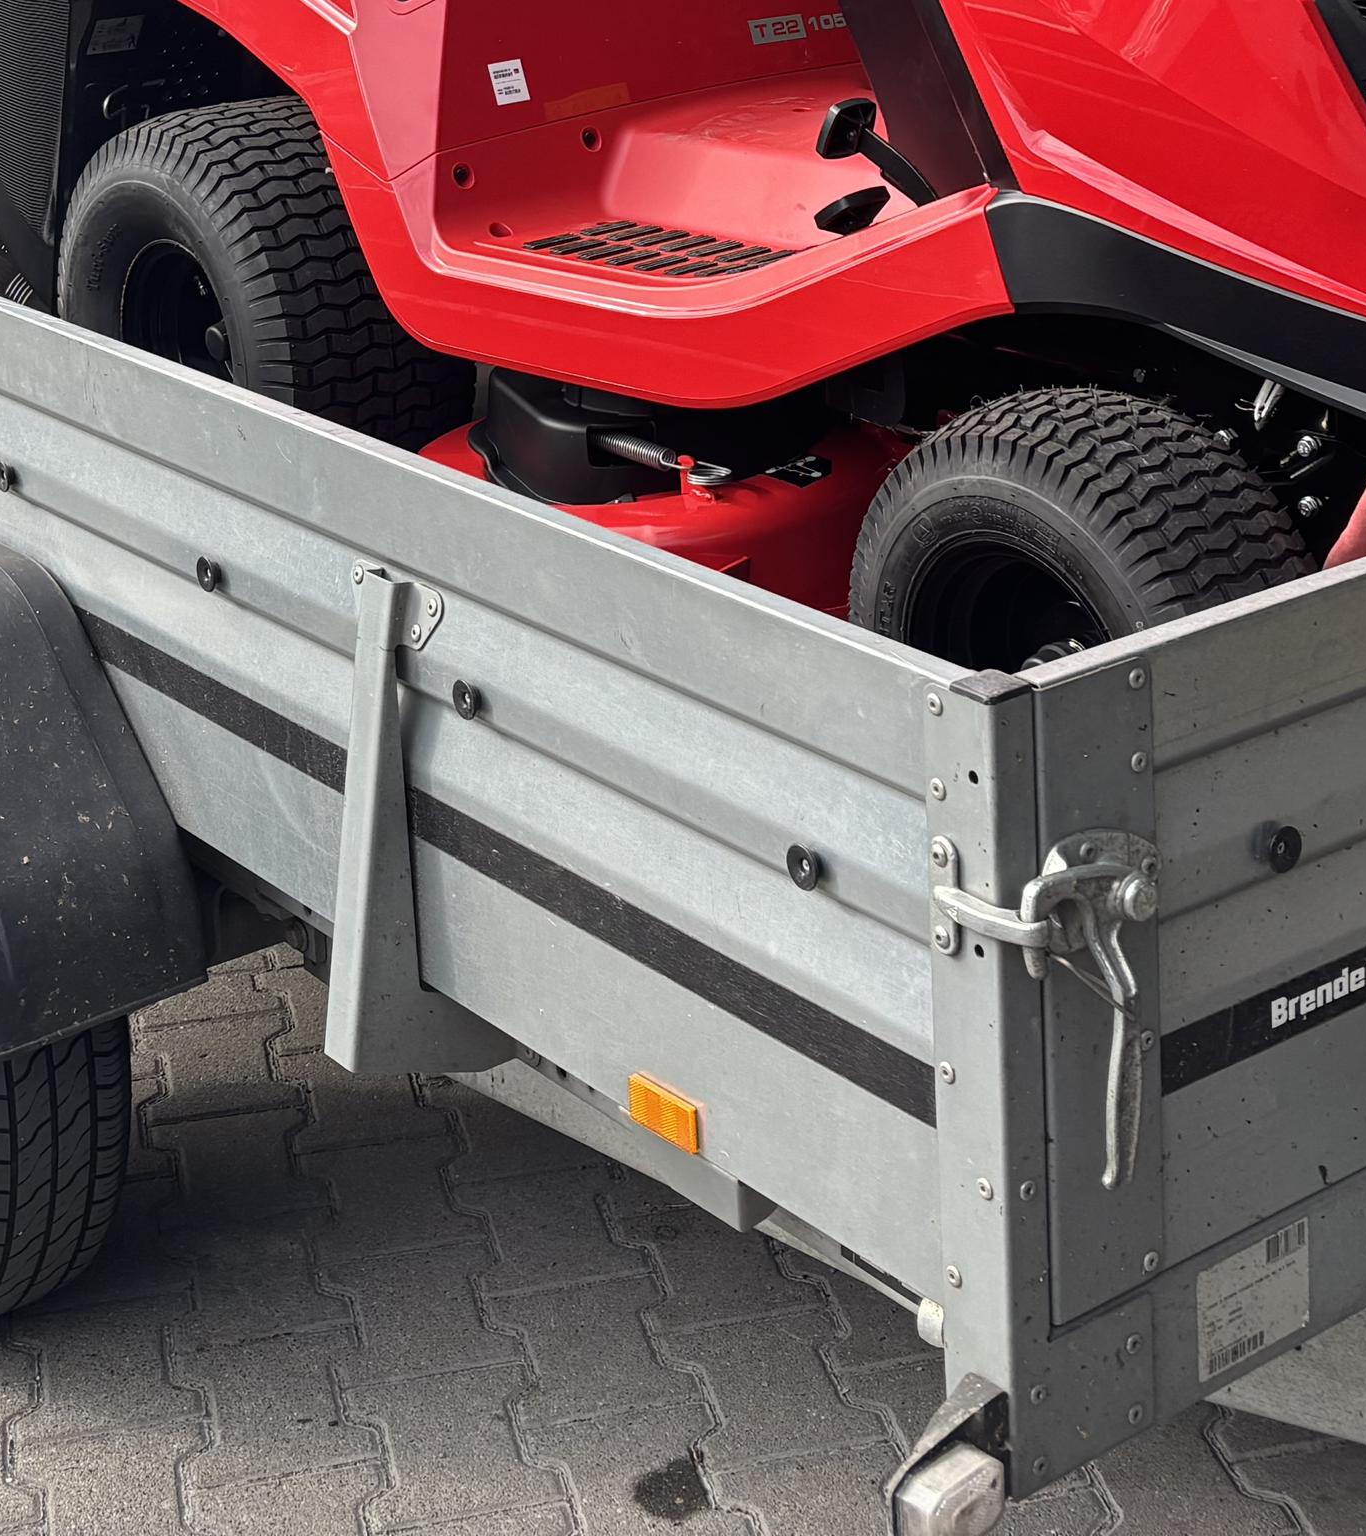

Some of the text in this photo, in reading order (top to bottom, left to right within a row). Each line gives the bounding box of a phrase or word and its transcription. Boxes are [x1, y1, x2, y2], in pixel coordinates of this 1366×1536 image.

[754, 12, 847, 39] T 22 105
